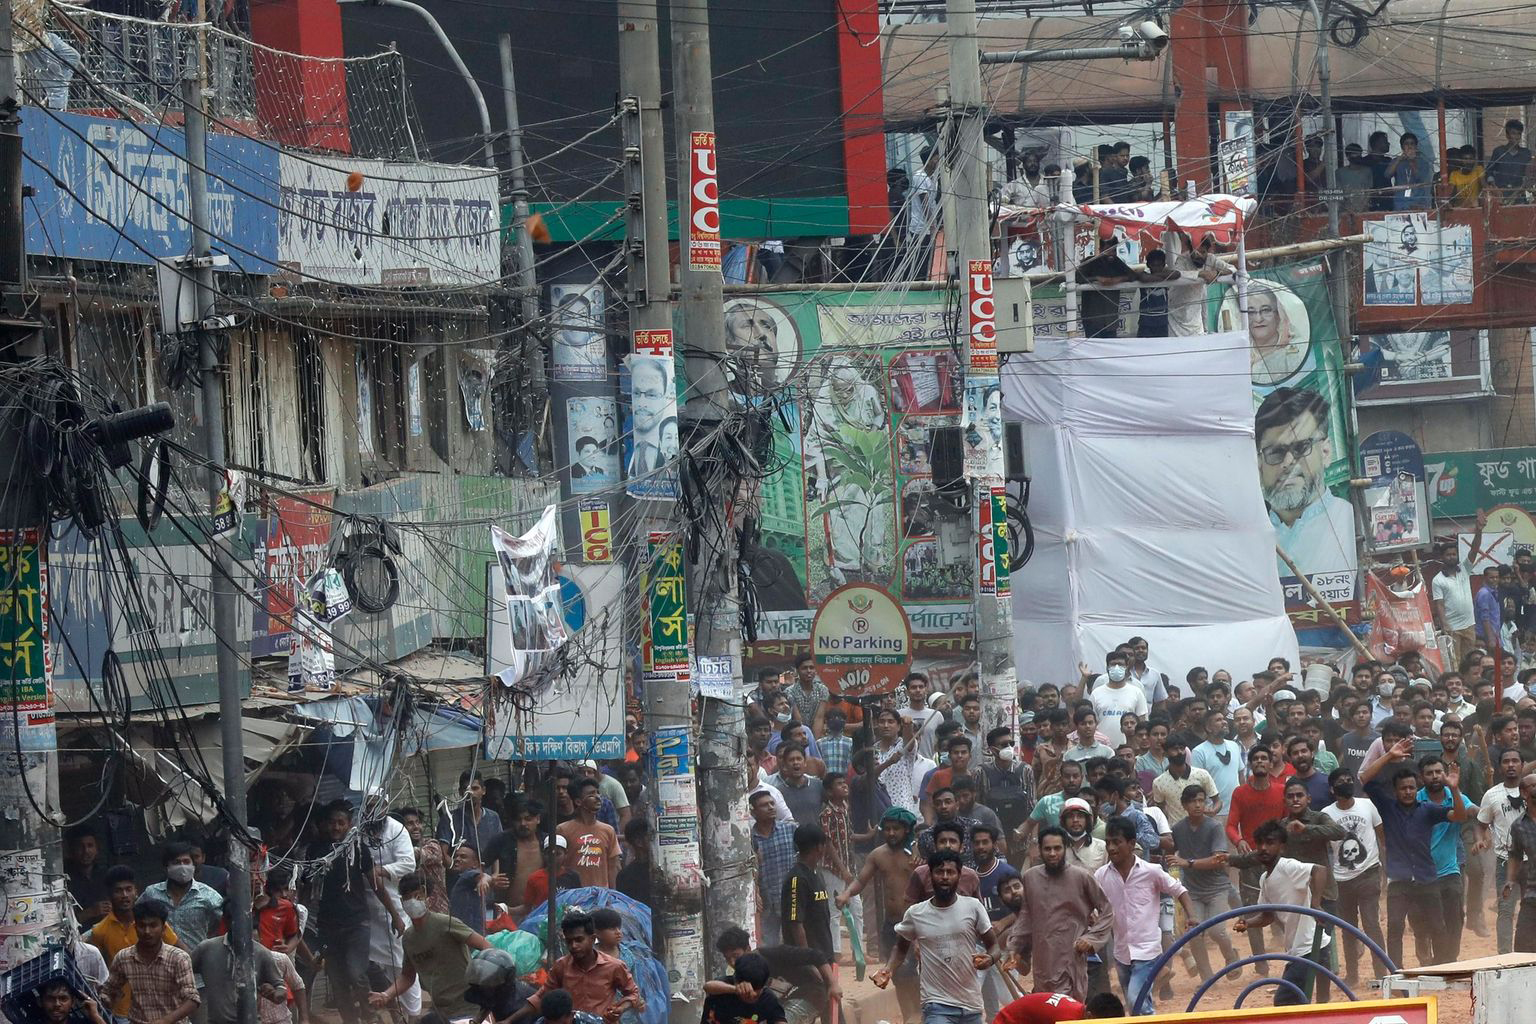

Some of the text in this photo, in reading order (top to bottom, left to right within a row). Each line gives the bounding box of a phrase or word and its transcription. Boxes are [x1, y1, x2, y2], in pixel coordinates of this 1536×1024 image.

[1476, 460, 1511, 487] ফুড
[819, 636, 840, 649] No
[843, 636, 902, 652] Parking
[874, 655, 897, 664] বিভাগ
[837, 669, 870, 692] MOJO
[542, 737, 563, 755] দক্ষিণ
[565, 737, 586, 755] বিভাগ
[592, 736, 621, 755] ডিএমপি
[580, 834, 601, 845] Free
[578, 845, 603, 856] Your
[577, 855, 601, 867] Mind
